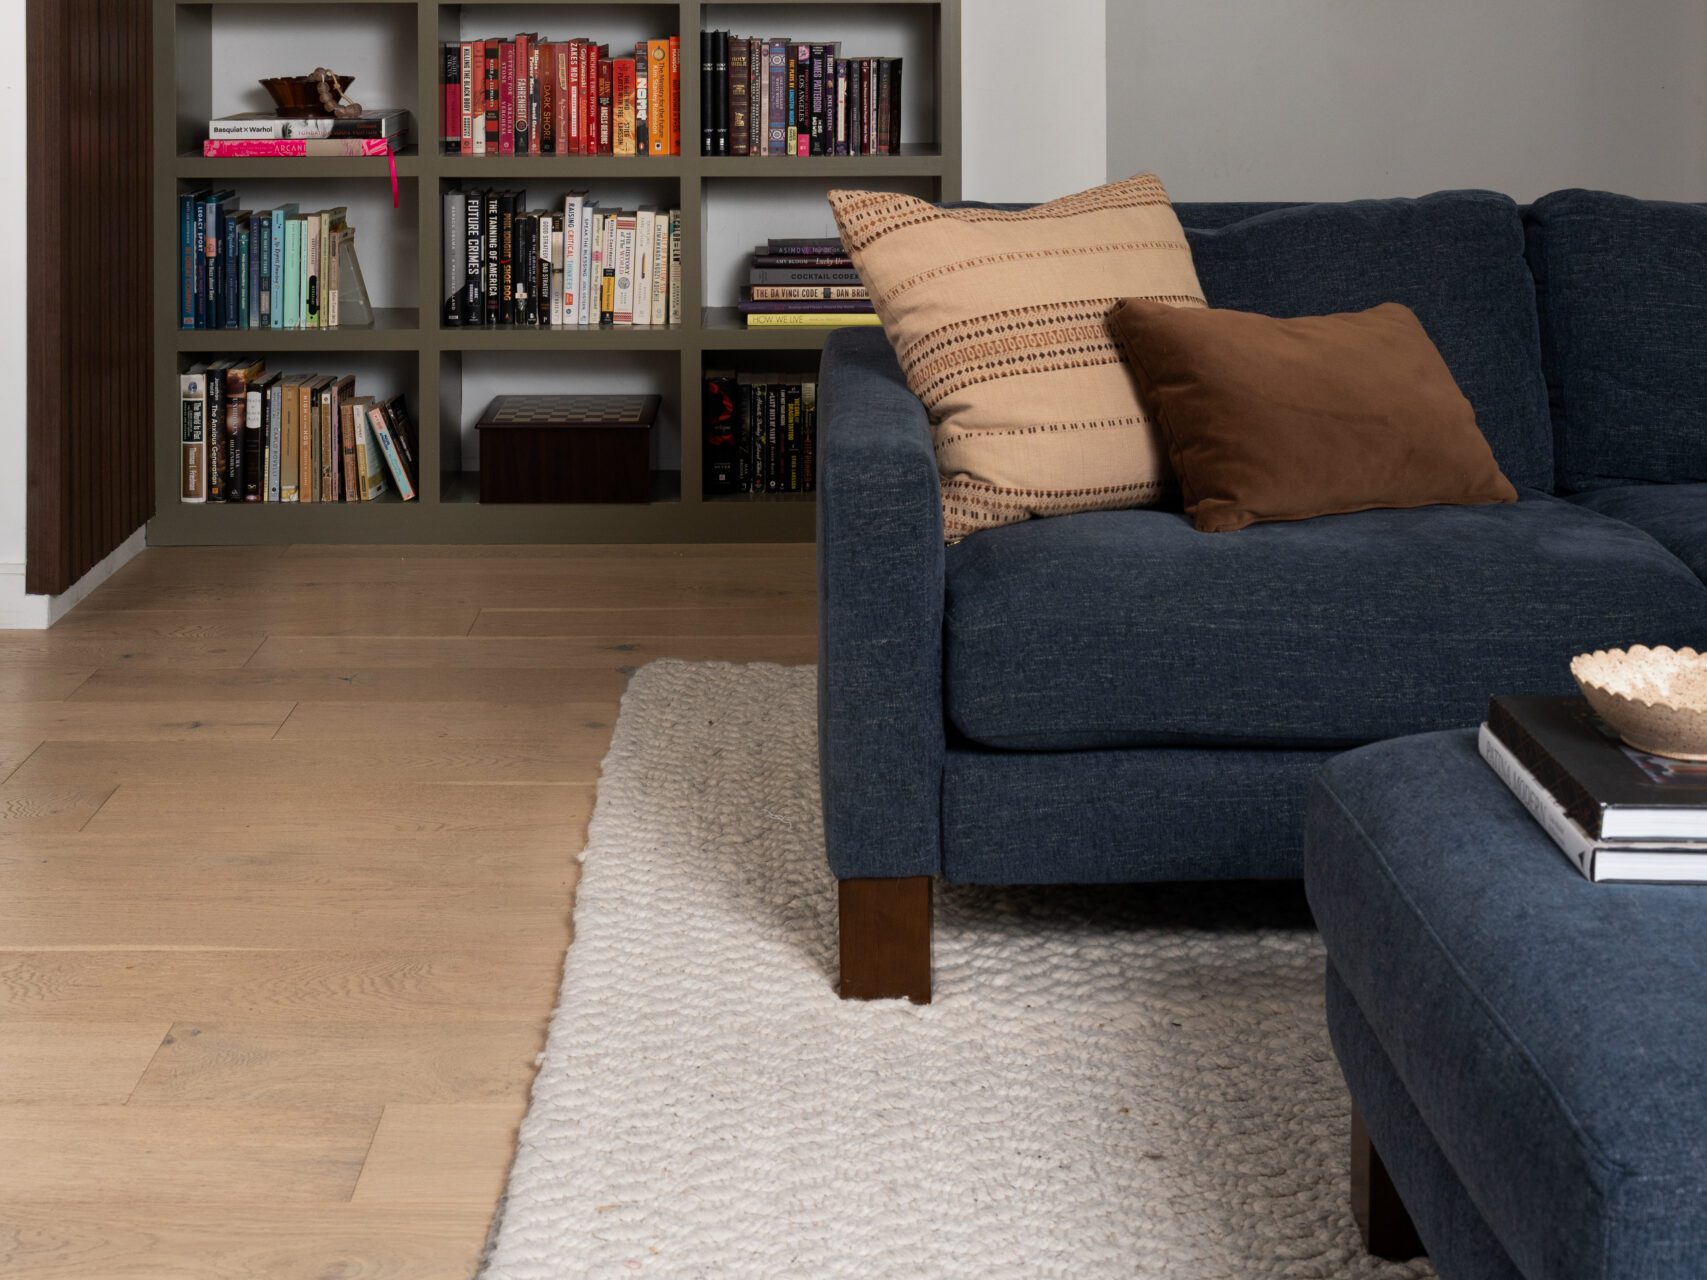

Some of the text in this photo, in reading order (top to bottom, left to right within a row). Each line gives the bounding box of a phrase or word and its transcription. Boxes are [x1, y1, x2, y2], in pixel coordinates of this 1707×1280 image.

[518, 78, 526, 118] FAHRENHEIT
[468, 200, 479, 274] FUTURE CRIMES
[489, 200, 497, 296] THE TANNING OF AMERICA
[756, 289, 818, 297] THE DA VINCI CODE
